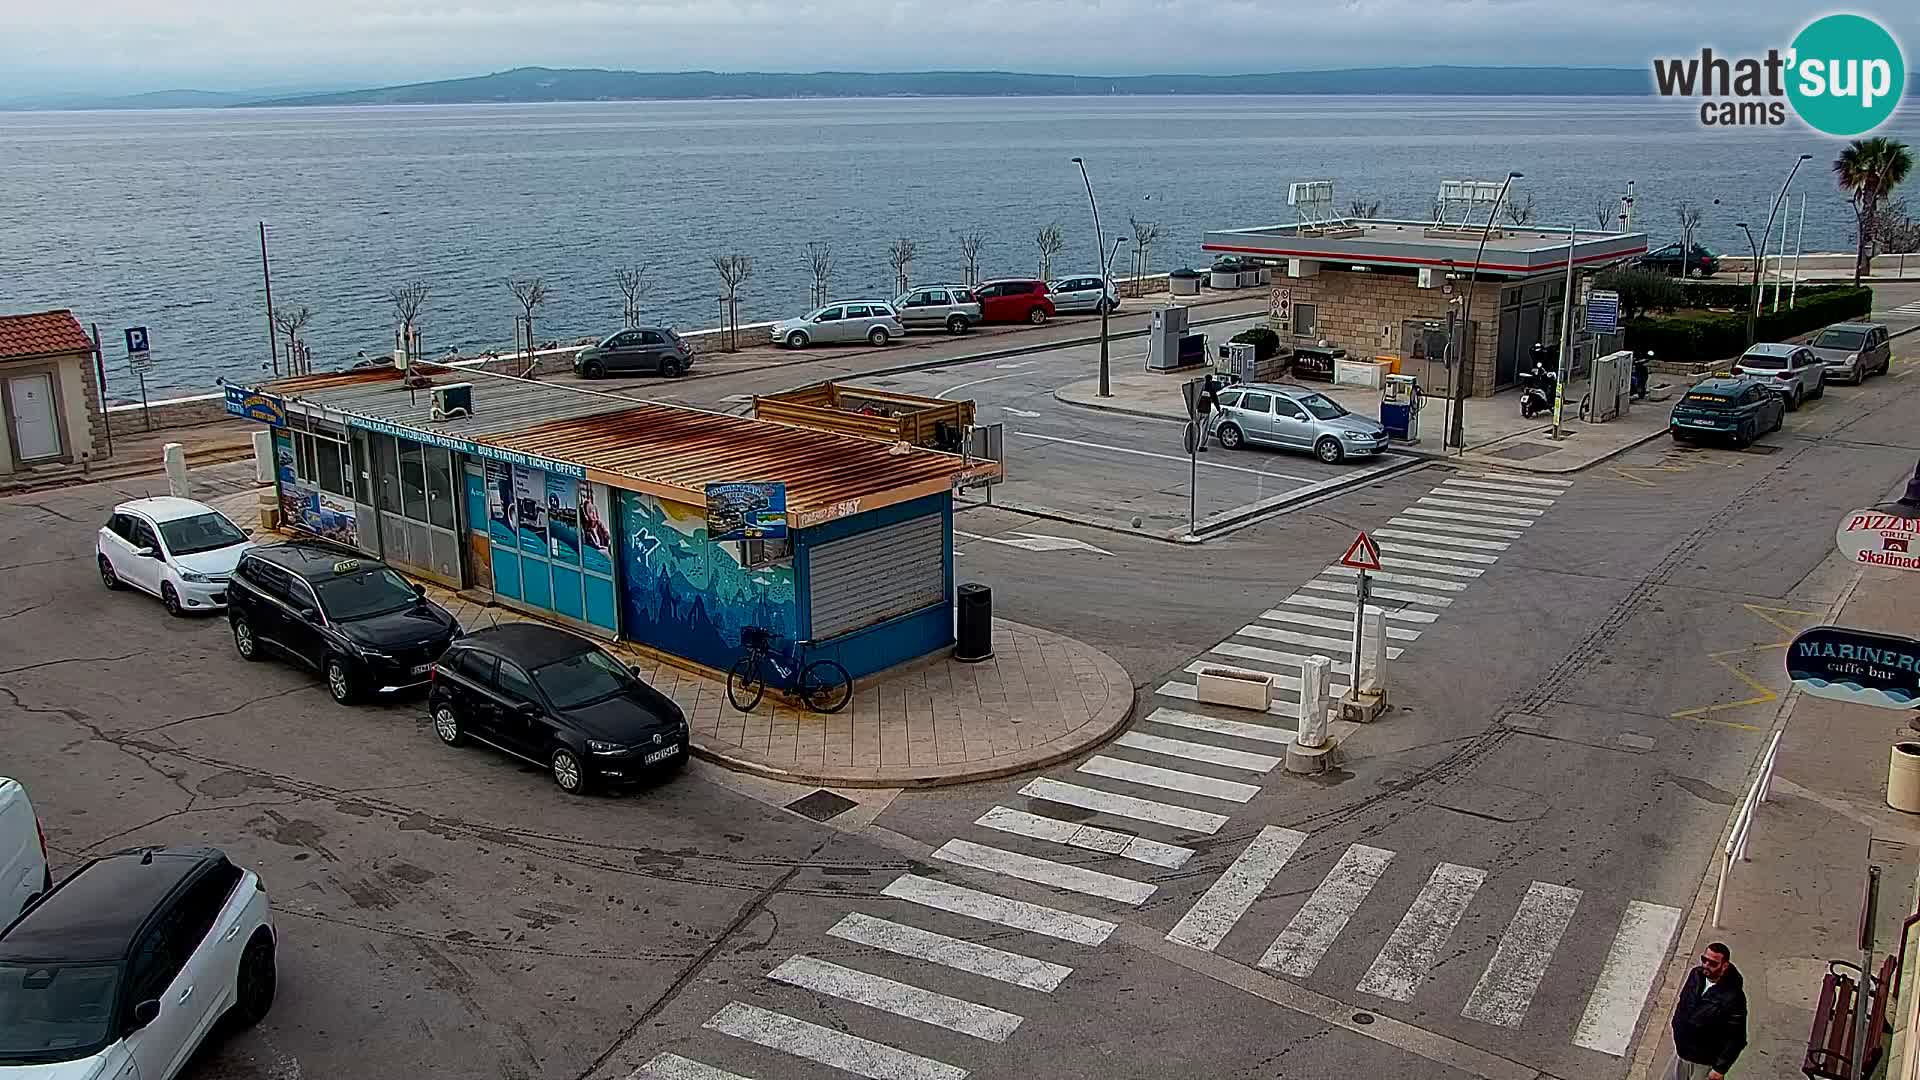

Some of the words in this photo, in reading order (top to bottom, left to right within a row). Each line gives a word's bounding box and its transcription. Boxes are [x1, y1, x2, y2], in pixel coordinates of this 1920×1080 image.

[130, 331, 143, 349] P
[373, 421, 396, 434] KARATA
[396, 427, 436, 443] AUTOBUSNA
[437, 436, 467, 450] POSTAJA
[478, 445, 492, 457] BUS
[494, 448, 526, 464] STATION
[527, 457, 553, 470] TICKET
[555, 463, 582, 476] OFFICE
[1880, 530, 1915, 540] GRILL
[1827, 662, 1864, 674] caffe
[1869, 665, 1895, 680] bar
